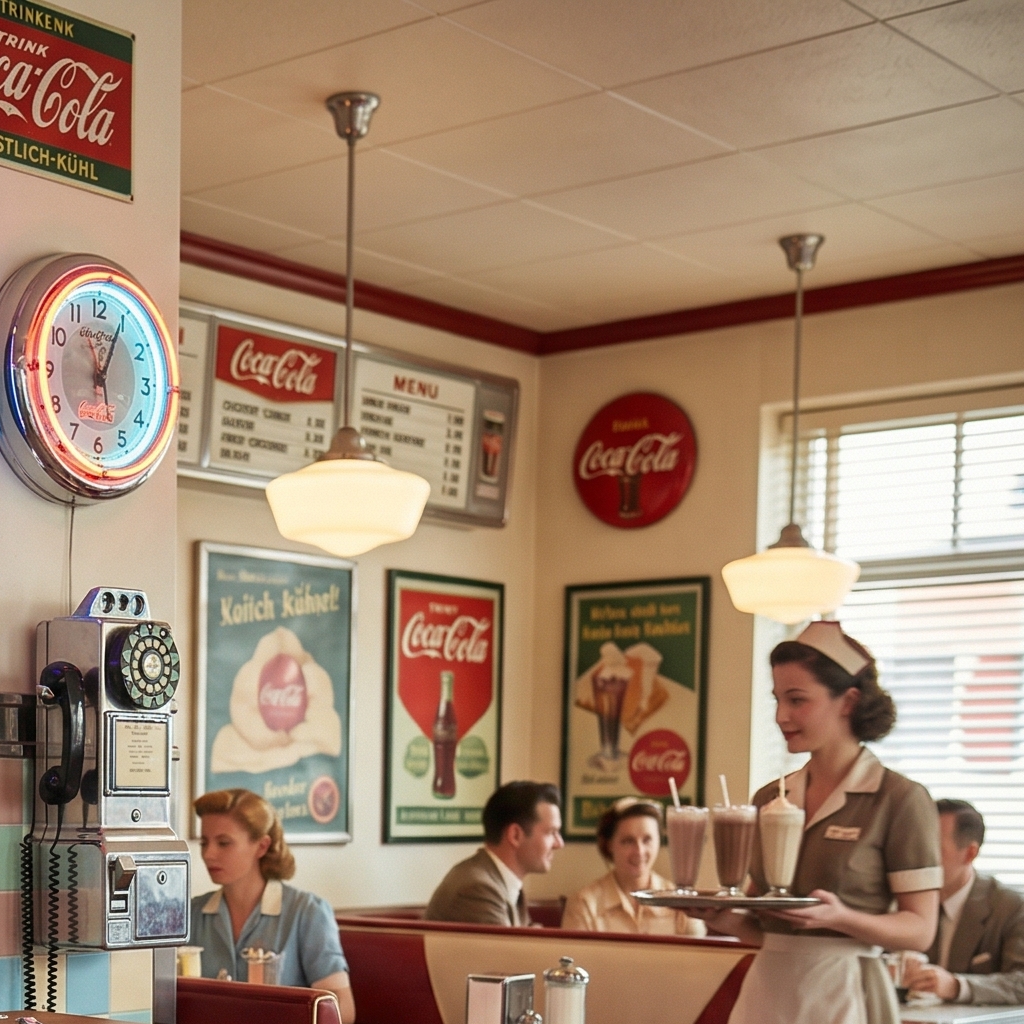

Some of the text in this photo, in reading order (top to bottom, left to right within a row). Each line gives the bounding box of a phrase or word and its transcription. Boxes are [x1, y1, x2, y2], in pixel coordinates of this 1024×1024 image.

[0, 0, 74, 38] TRINKENK
[70, 303, 81, 323] 11
[92, 298, 107, 320] 12
[51, 326, 67, 346] 10
[134, 343, 145, 361] 2
[45, 361, 54, 379] 9
[230, 338, 322, 395] Coca-Cola
[141, 377, 151, 396] 3
[393, 374, 439, 399] MENU
[51, 395, 61, 414] 8
[133, 410, 144, 428] 4
[69, 423, 80, 440] 7
[117, 430, 127, 448] 5
[93, 436, 103, 454] 6
[579, 431, 684, 480] Coca-Cola
[402, 611, 491, 663] Coca-Cola
